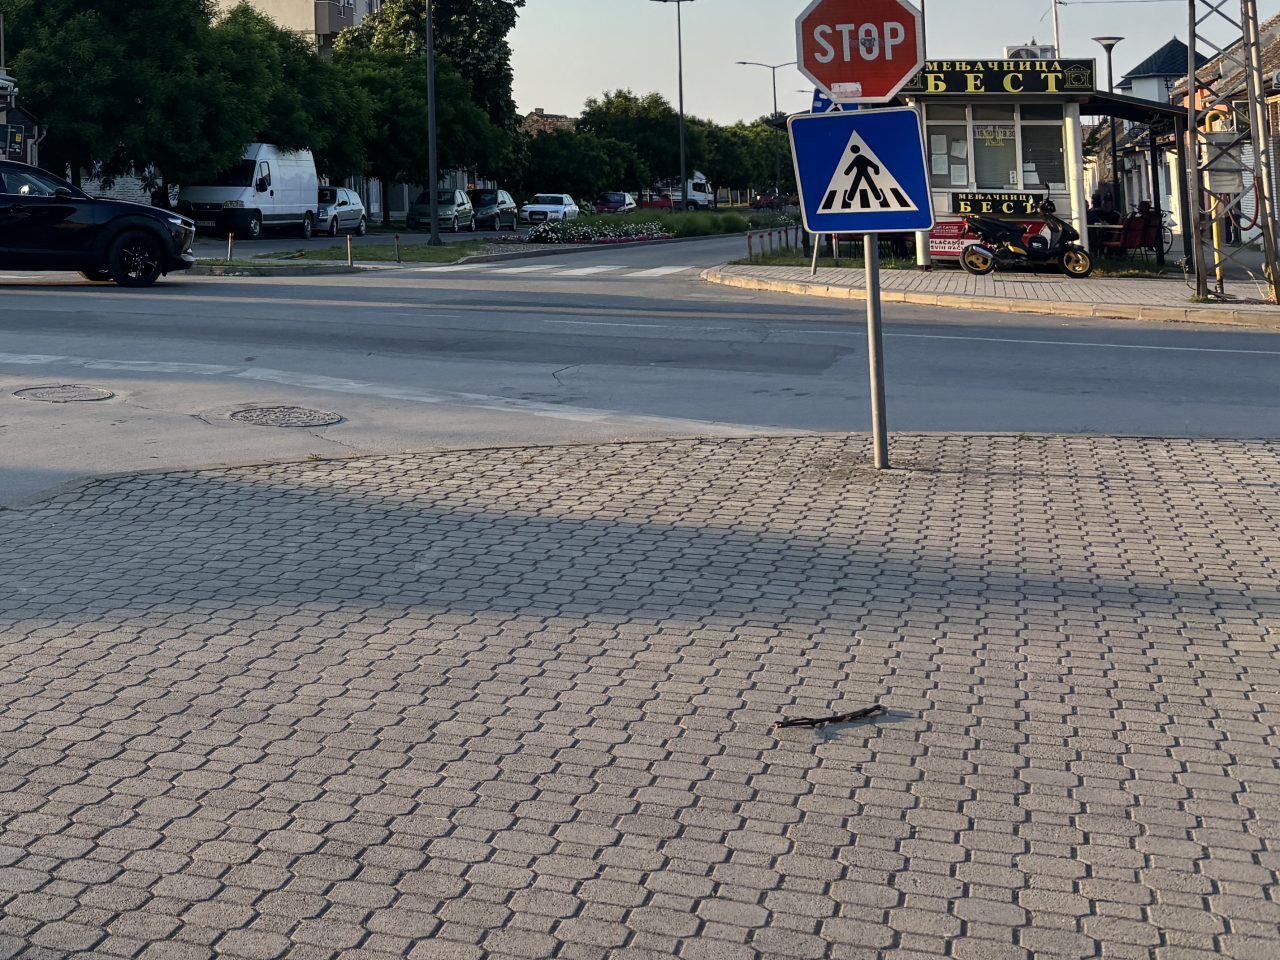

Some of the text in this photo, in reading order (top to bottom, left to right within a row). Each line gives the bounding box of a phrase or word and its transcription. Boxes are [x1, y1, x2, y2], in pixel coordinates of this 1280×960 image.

[813, 21, 905, 63] STOP
[925, 61, 1062, 72] МЕЊАЧНИЦА
[924, 73, 1062, 92] БЕСТ
[958, 193, 1035, 201] МЕЊАЧНИЦА
[959, 201, 1036, 213] БЕСТ
